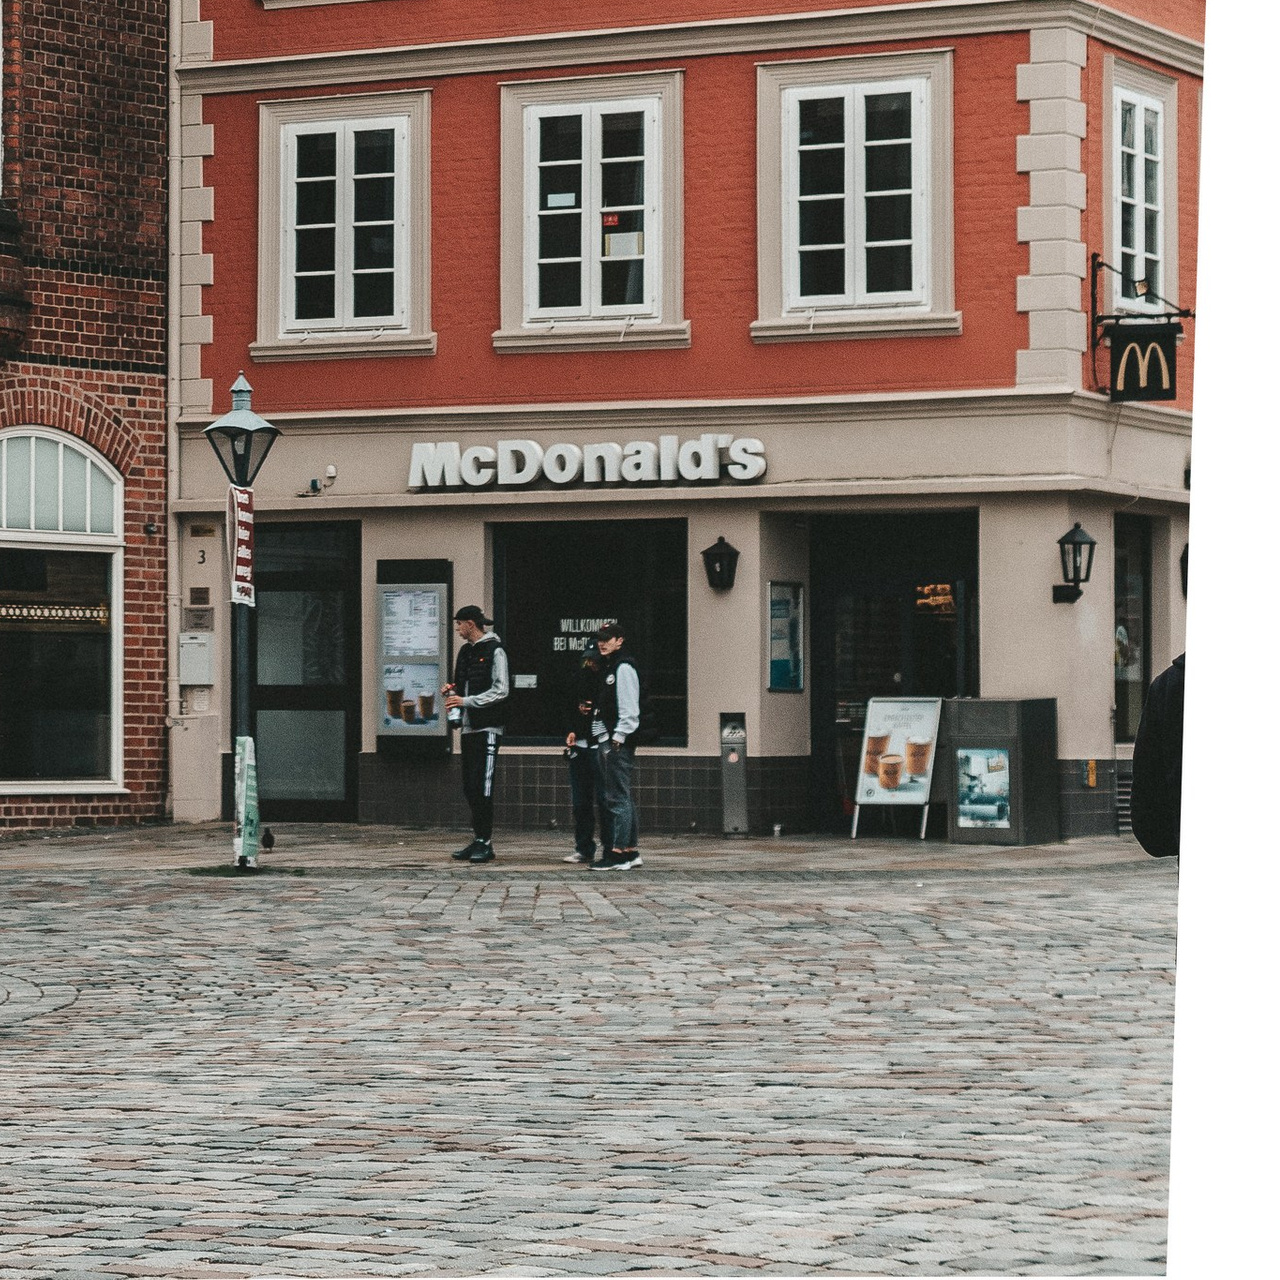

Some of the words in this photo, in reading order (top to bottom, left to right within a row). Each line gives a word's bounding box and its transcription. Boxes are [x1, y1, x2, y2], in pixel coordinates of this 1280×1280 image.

[408, 433, 767, 487] McDonald's
[197, 549, 206, 564] 3
[553, 637, 566, 651] BEI
